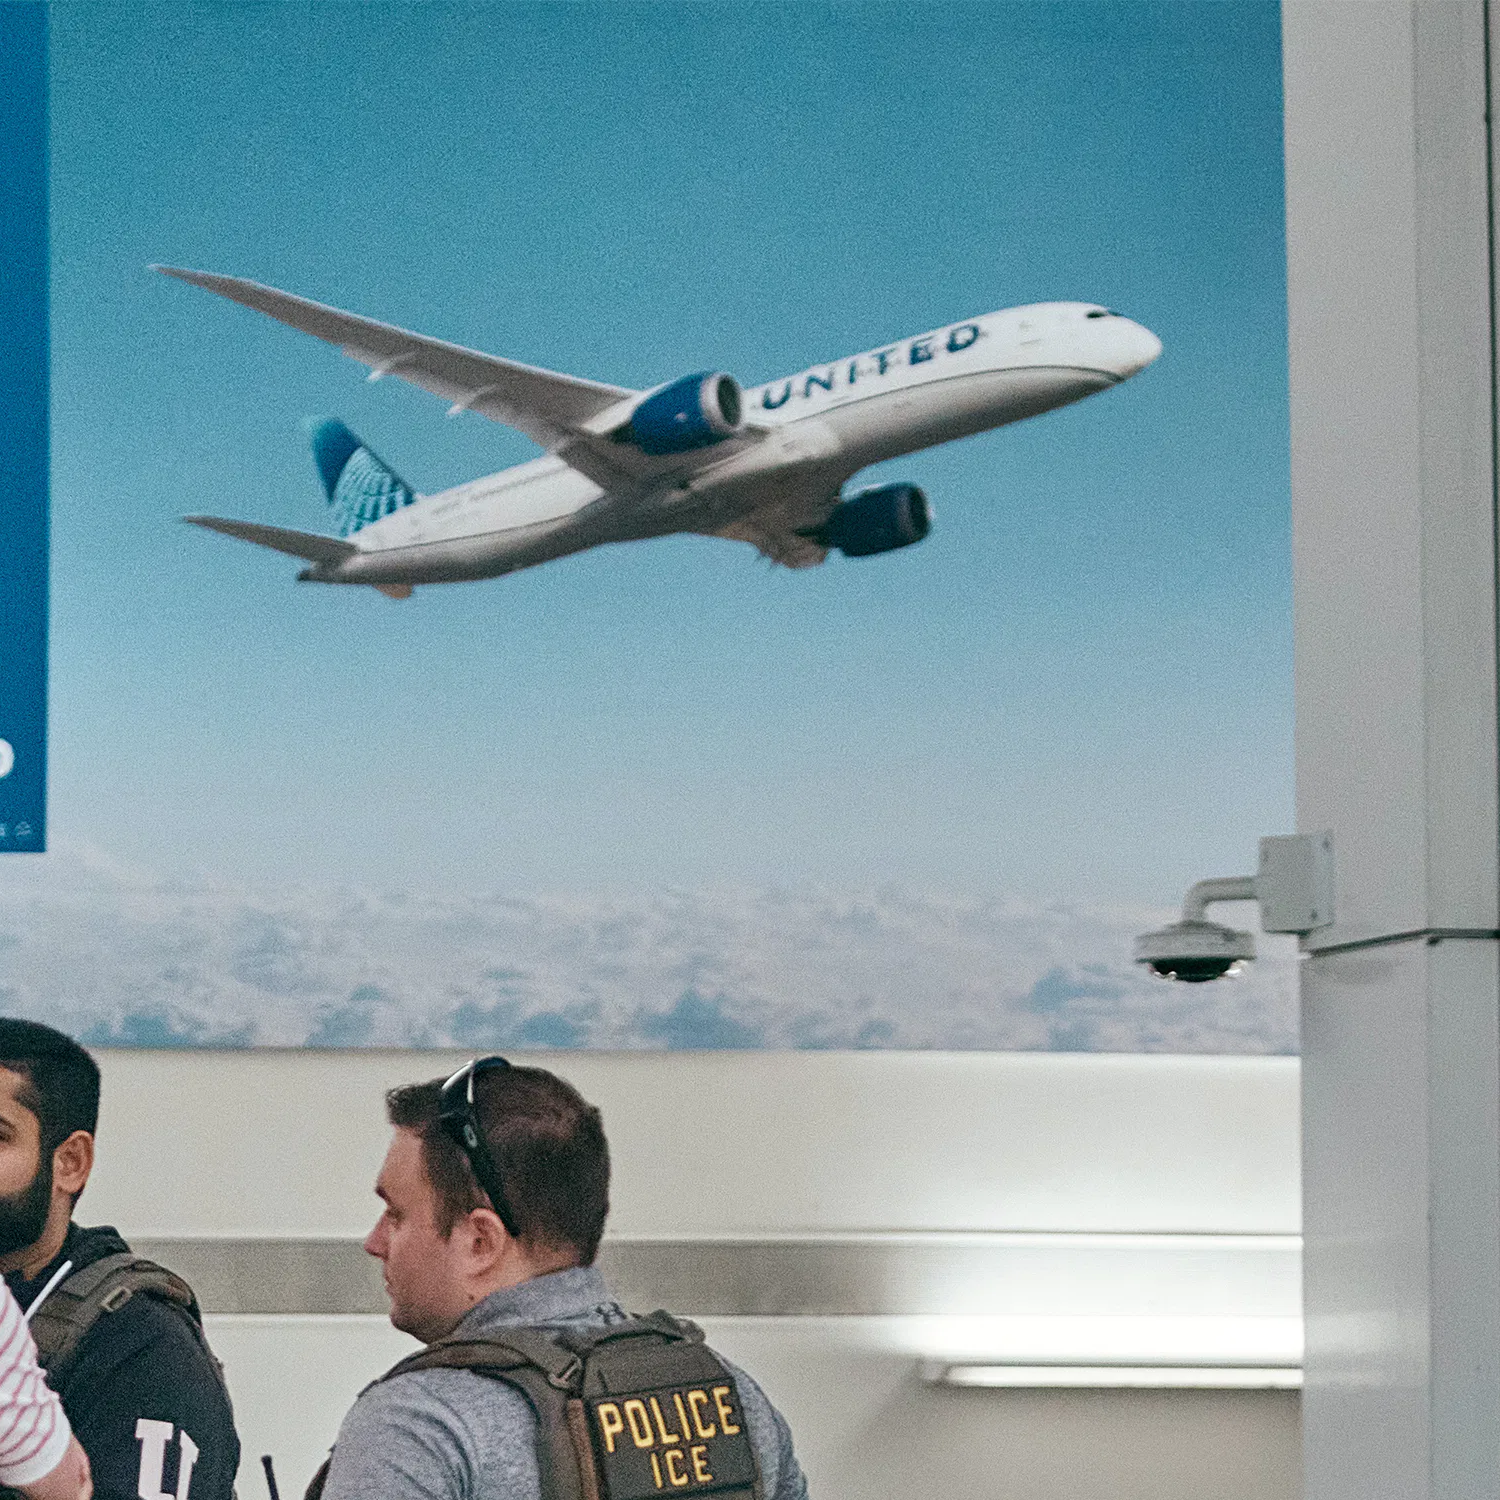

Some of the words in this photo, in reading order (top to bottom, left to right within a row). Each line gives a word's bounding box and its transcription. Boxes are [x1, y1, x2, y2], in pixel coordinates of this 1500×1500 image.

[761, 323, 980, 410] UNITED
[598, 1385, 741, 1453] POLICE
[650, 1444, 714, 1489] ICE
